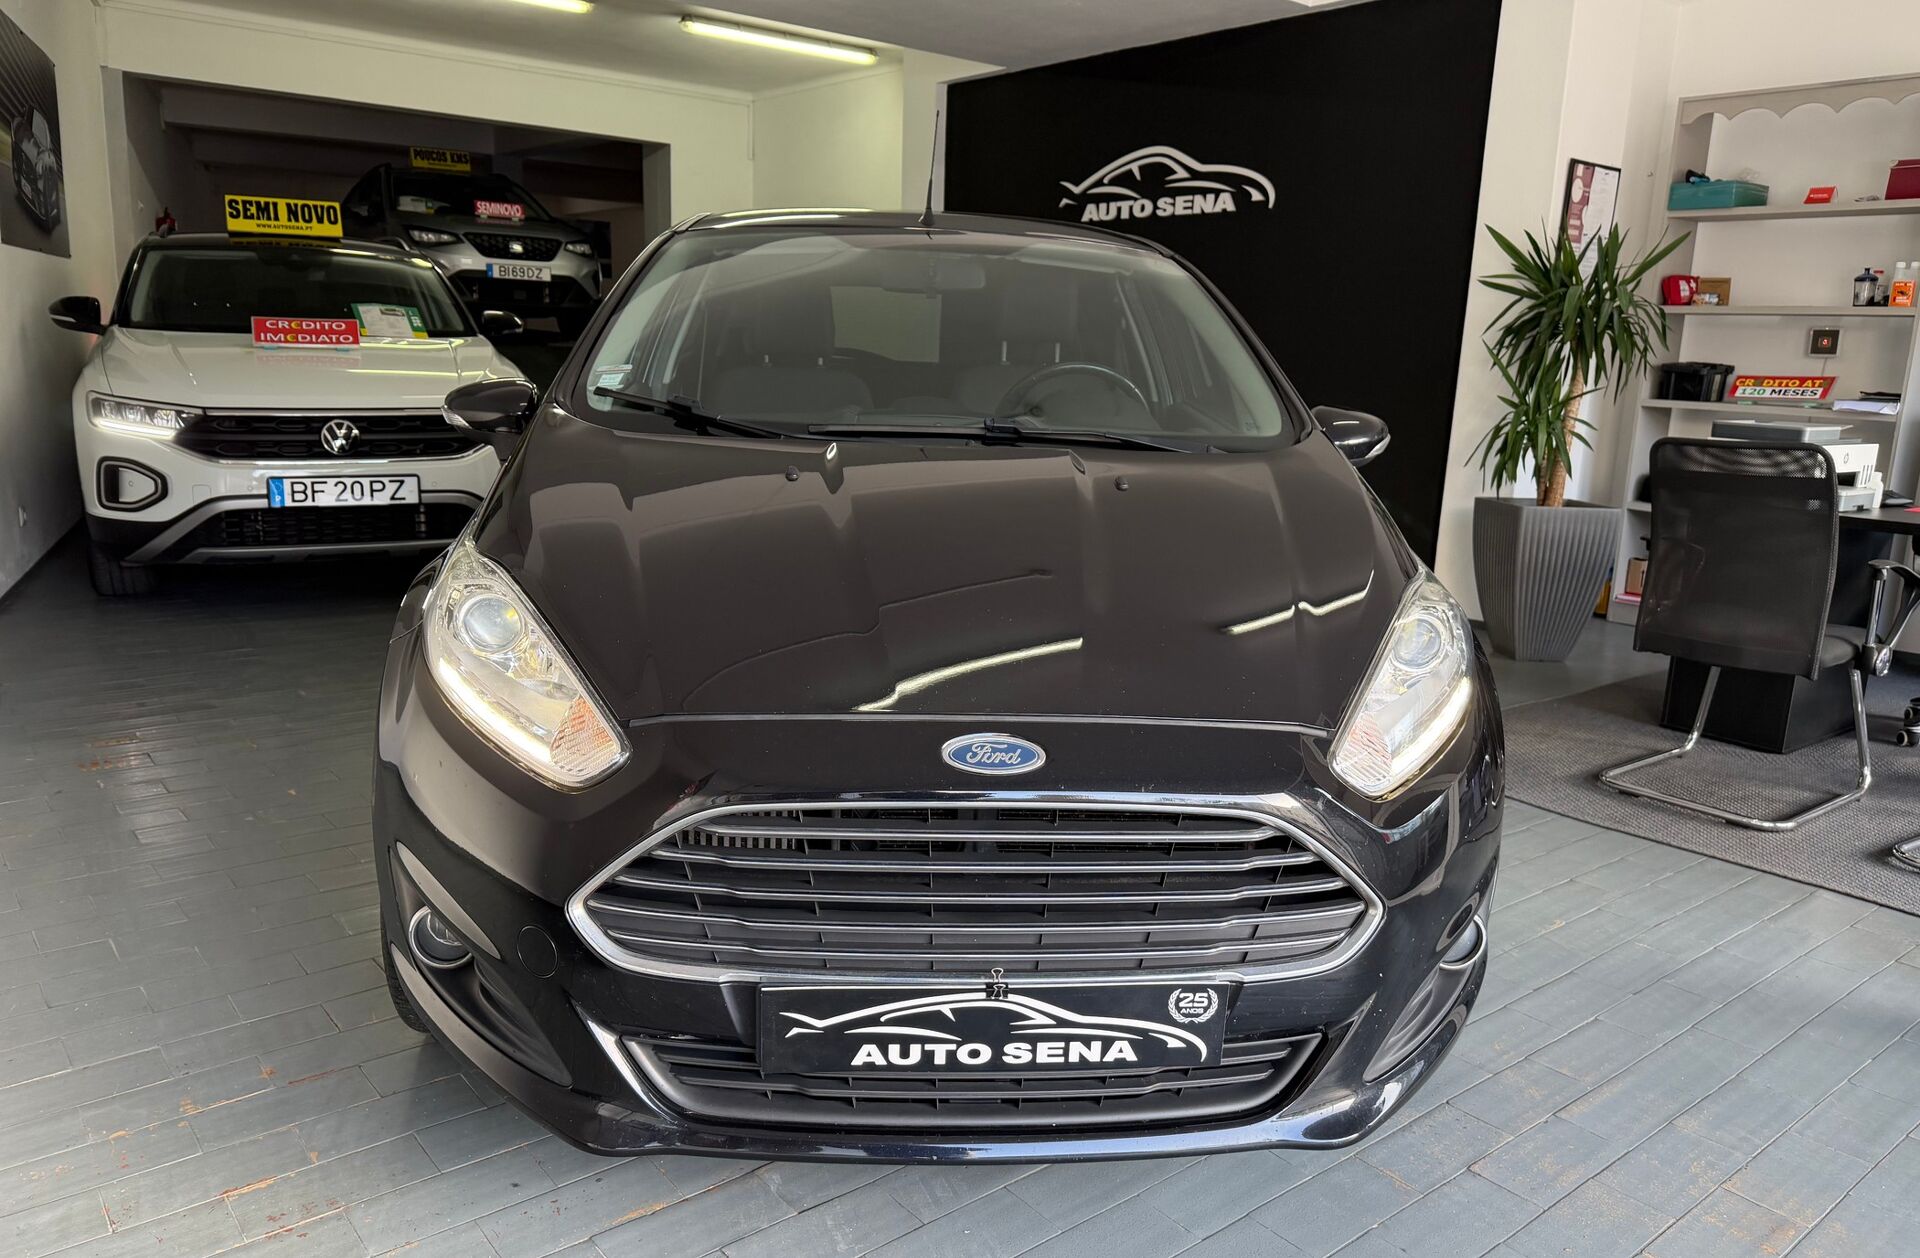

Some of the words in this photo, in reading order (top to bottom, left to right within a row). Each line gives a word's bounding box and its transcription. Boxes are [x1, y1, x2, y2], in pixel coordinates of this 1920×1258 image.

[227, 198, 280, 221] SEMI
[285, 202, 339, 225] NOVO
[476, 201, 522, 217] SEMINOVO
[1081, 198, 1153, 222] AUTO
[1155, 192, 1236, 217] SENA
[1741, 388, 1766, 396] 120
[966, 742, 1021, 764] Ford
[1179, 992, 1208, 1007] 25
[850, 1043, 992, 1065] AUTO
[1002, 1040, 1138, 1064] SENA
